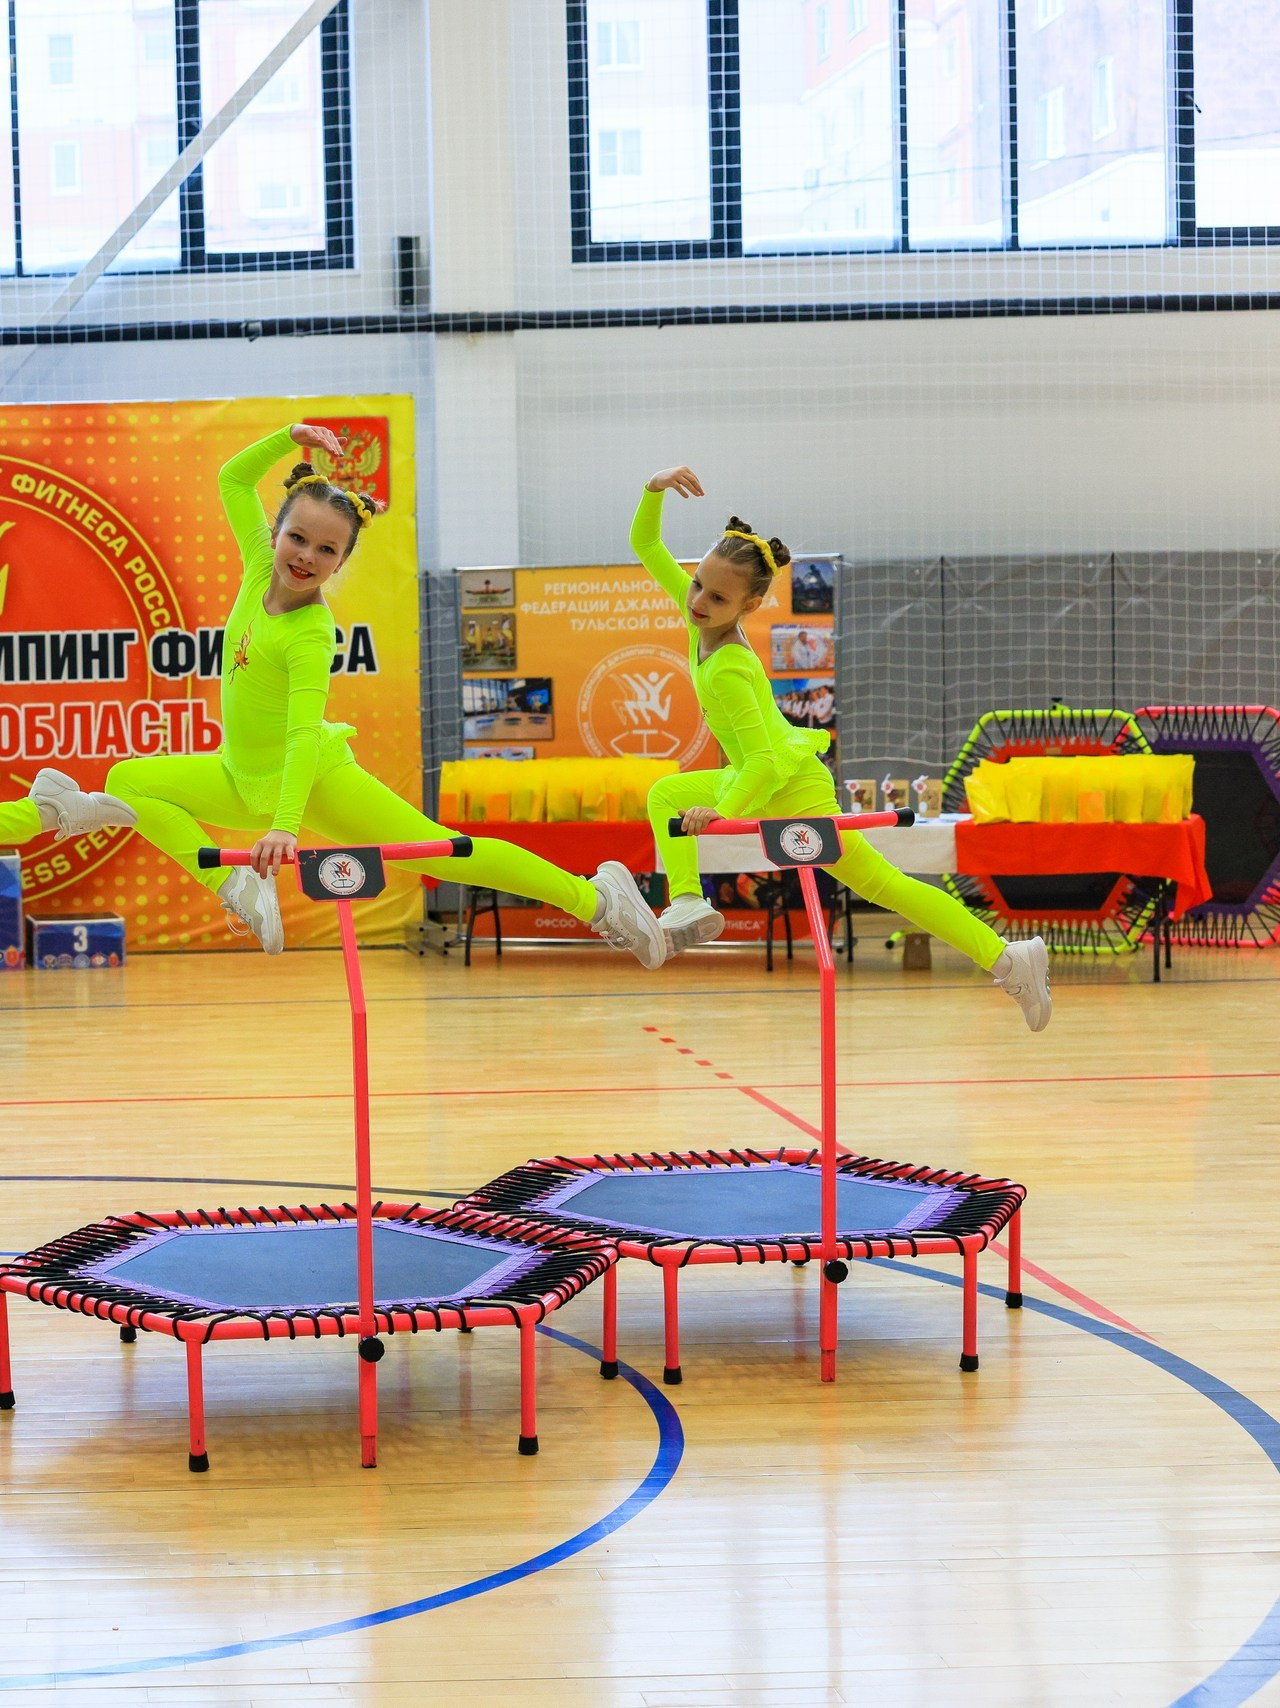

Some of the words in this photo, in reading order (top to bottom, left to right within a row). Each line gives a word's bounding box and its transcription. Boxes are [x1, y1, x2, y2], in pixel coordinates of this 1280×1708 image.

[10, 473, 128, 558] ФИТНЕСА
[123, 555, 174, 634] РОСС
[520, 598, 611, 615] ФЕДЕРАЦИИ
[613, 597, 679, 613] ДЖАМП
[570, 614, 650, 632] ТУЛЬСКОЙ
[149, 622, 380, 680] ФИСА
[73, 925, 88, 952] 3
